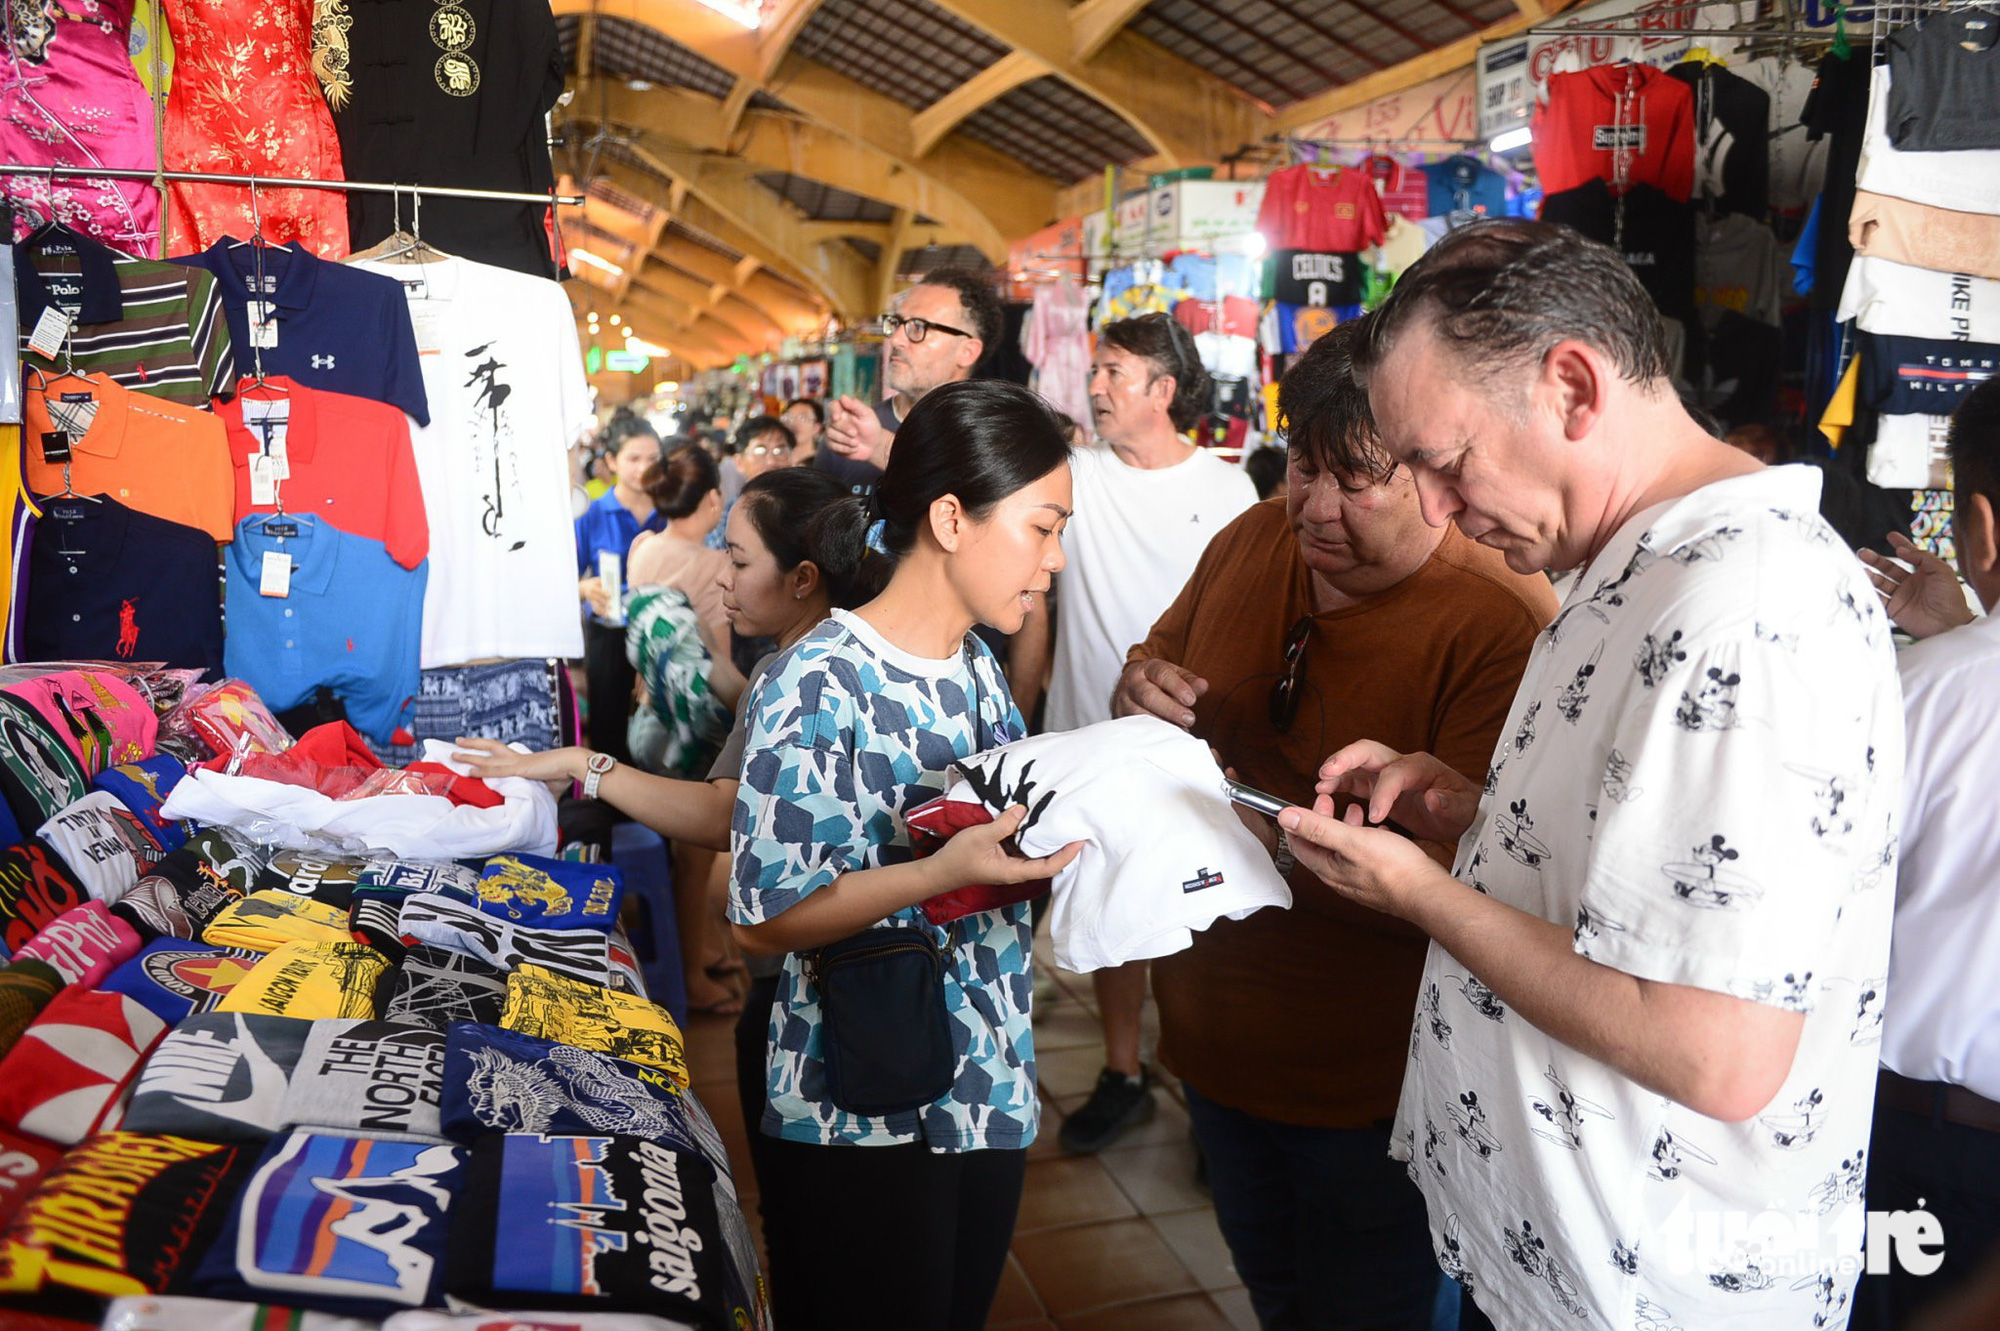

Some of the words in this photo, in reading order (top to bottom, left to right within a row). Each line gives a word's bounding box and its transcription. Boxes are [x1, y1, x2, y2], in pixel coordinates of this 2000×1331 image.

[1292, 254, 1343, 283] CELTICS
[51, 284, 80, 295] Polo
[1951, 272, 1971, 312] IKE
[1925, 355, 2000, 368] TOMM
[150, 968, 195, 994] GOOD
[134, 1028, 243, 1102] NIKE
[320, 1037, 377, 1076] THE
[359, 1040, 427, 1131] NORTH
[629, 1140, 703, 1301] saigonia
